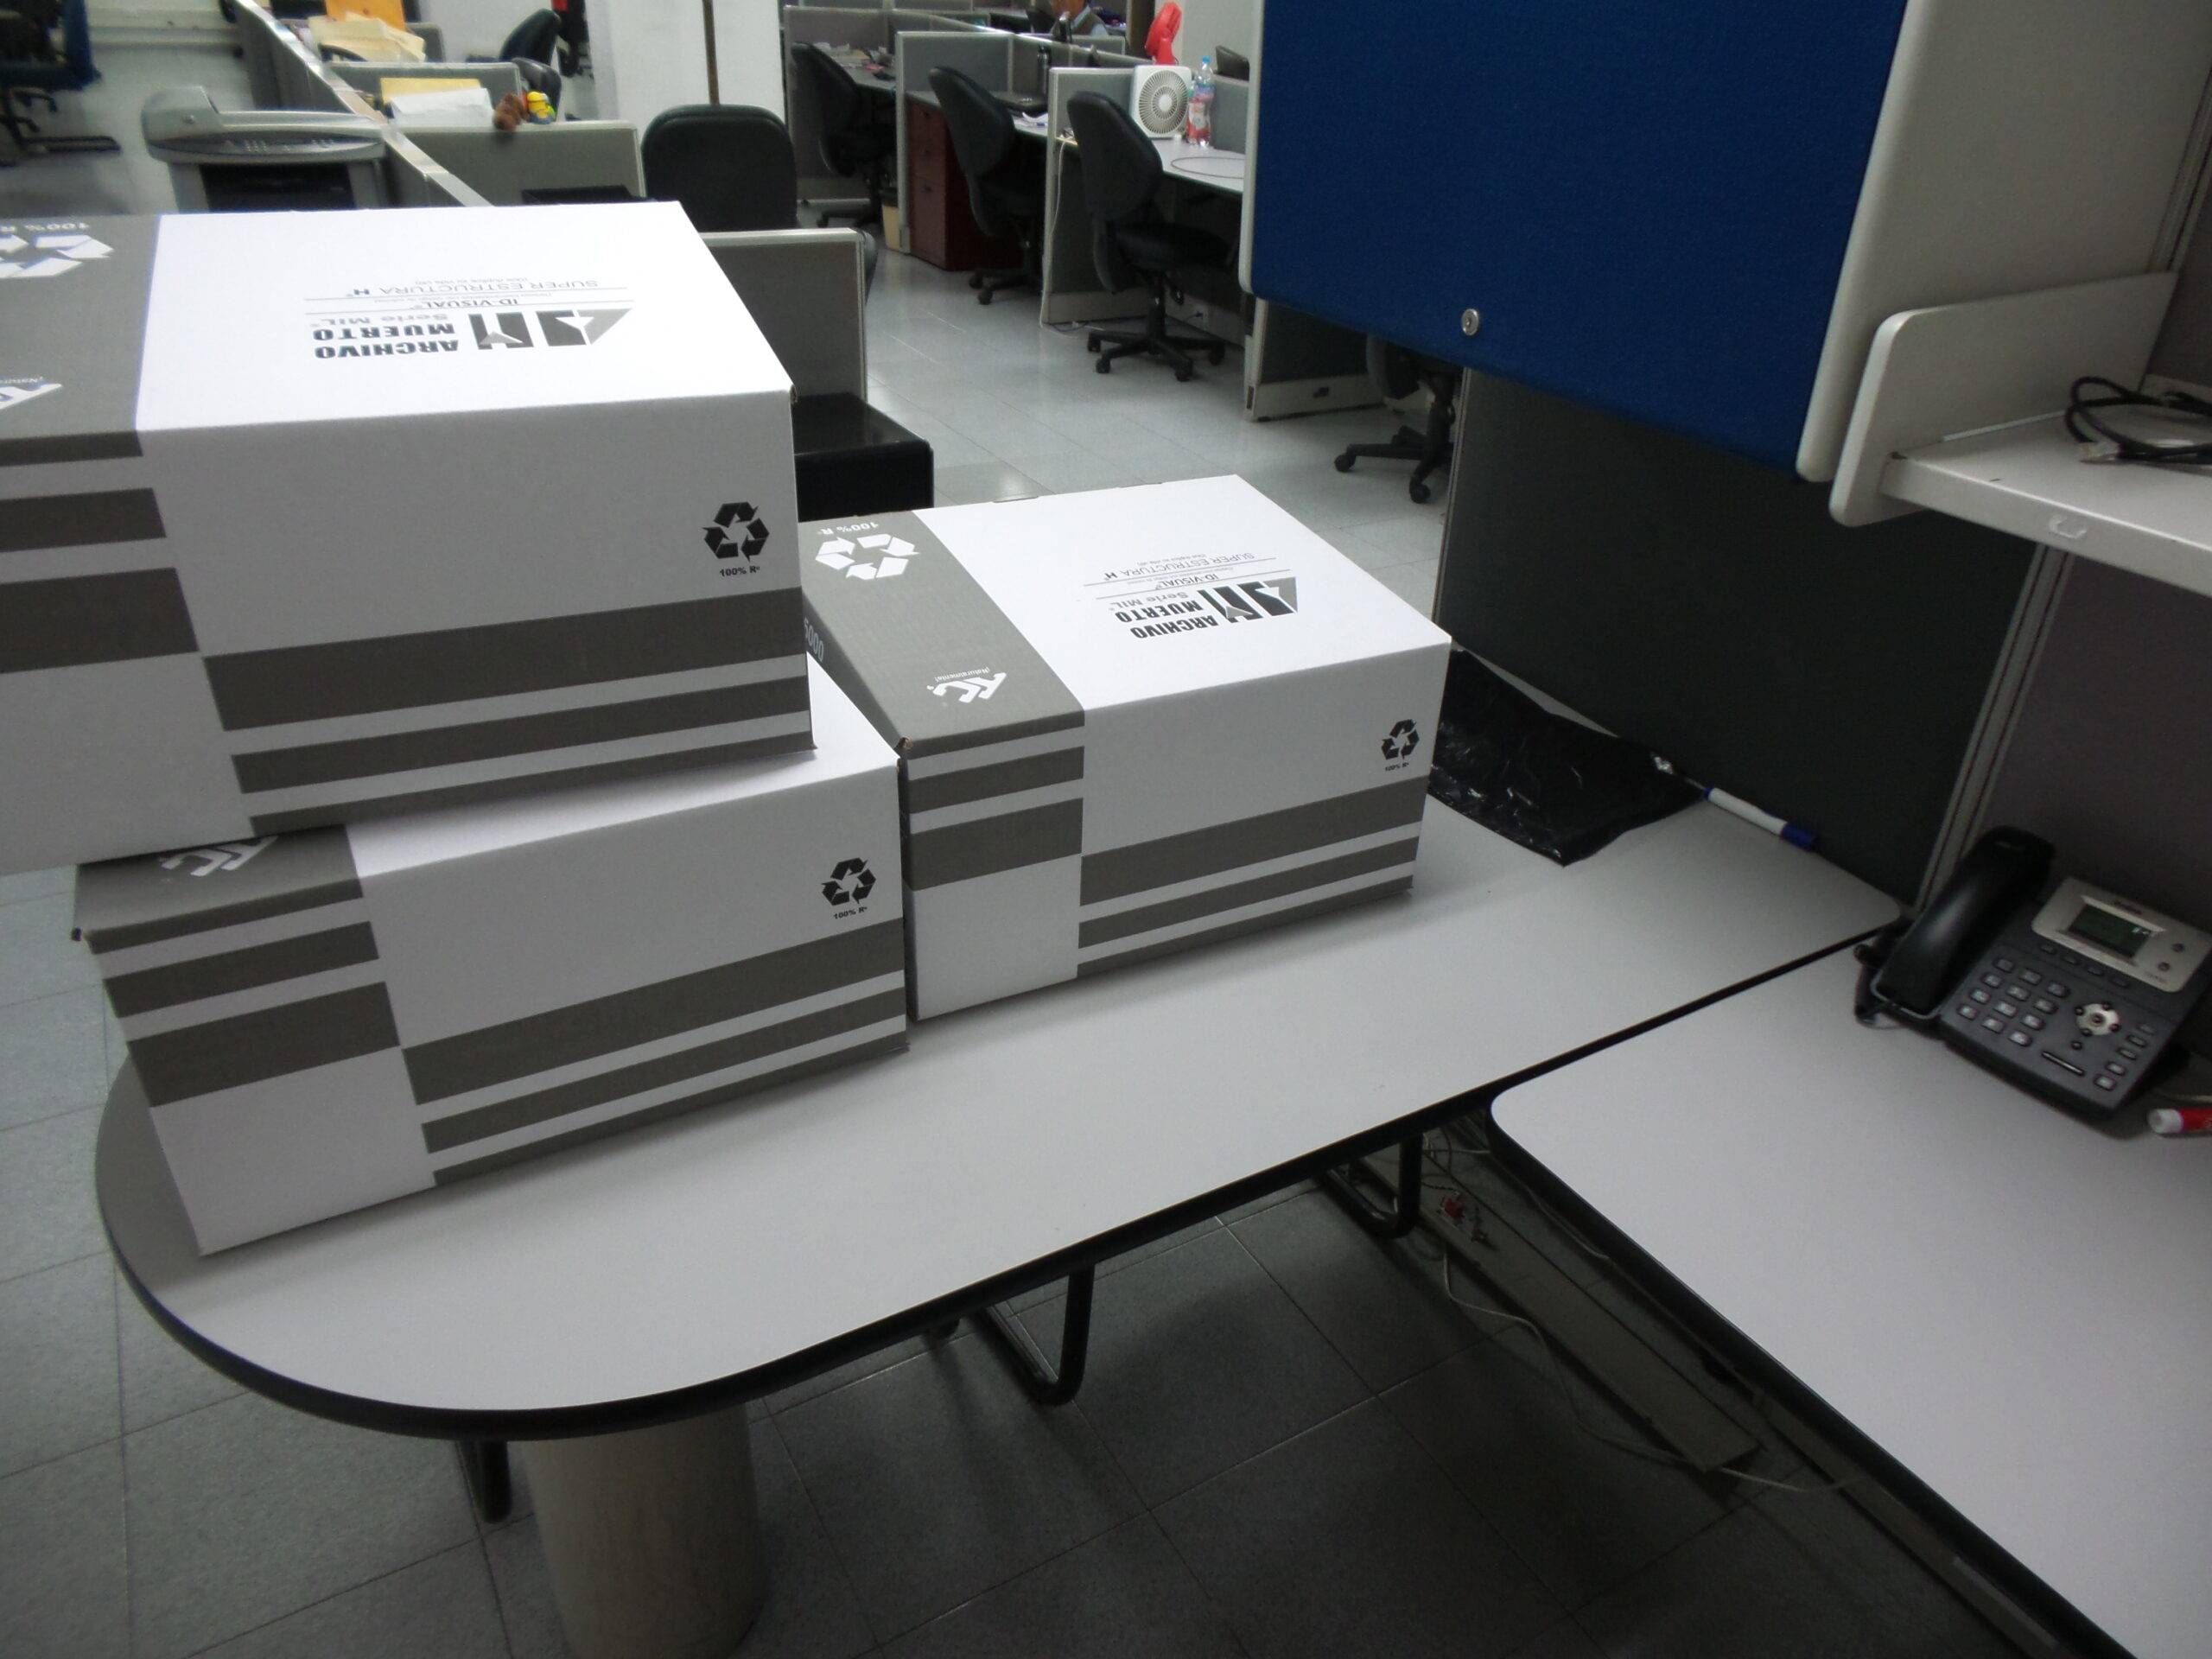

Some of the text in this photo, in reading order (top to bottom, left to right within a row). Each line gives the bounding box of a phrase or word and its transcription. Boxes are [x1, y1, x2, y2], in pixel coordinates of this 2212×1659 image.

[380, 283, 523, 295] ESTRUCTURA
[531, 280, 599, 290] SUPER
[381, 314, 448, 323] Serie
[313, 323, 455, 340] MUERTO
[315, 340, 459, 359] ARCHIVO
[836, 521, 879, 533] 100%
[1211, 552, 1255, 565] SUPER
[720, 567, 747, 577] 100%
[1120, 559, 1217, 576] ESTRUCTURA
[1145, 592, 1188, 603] Serie
[1115, 600, 1205, 623] MUERTO
[1129, 614, 1220, 639] ARCHIVO
